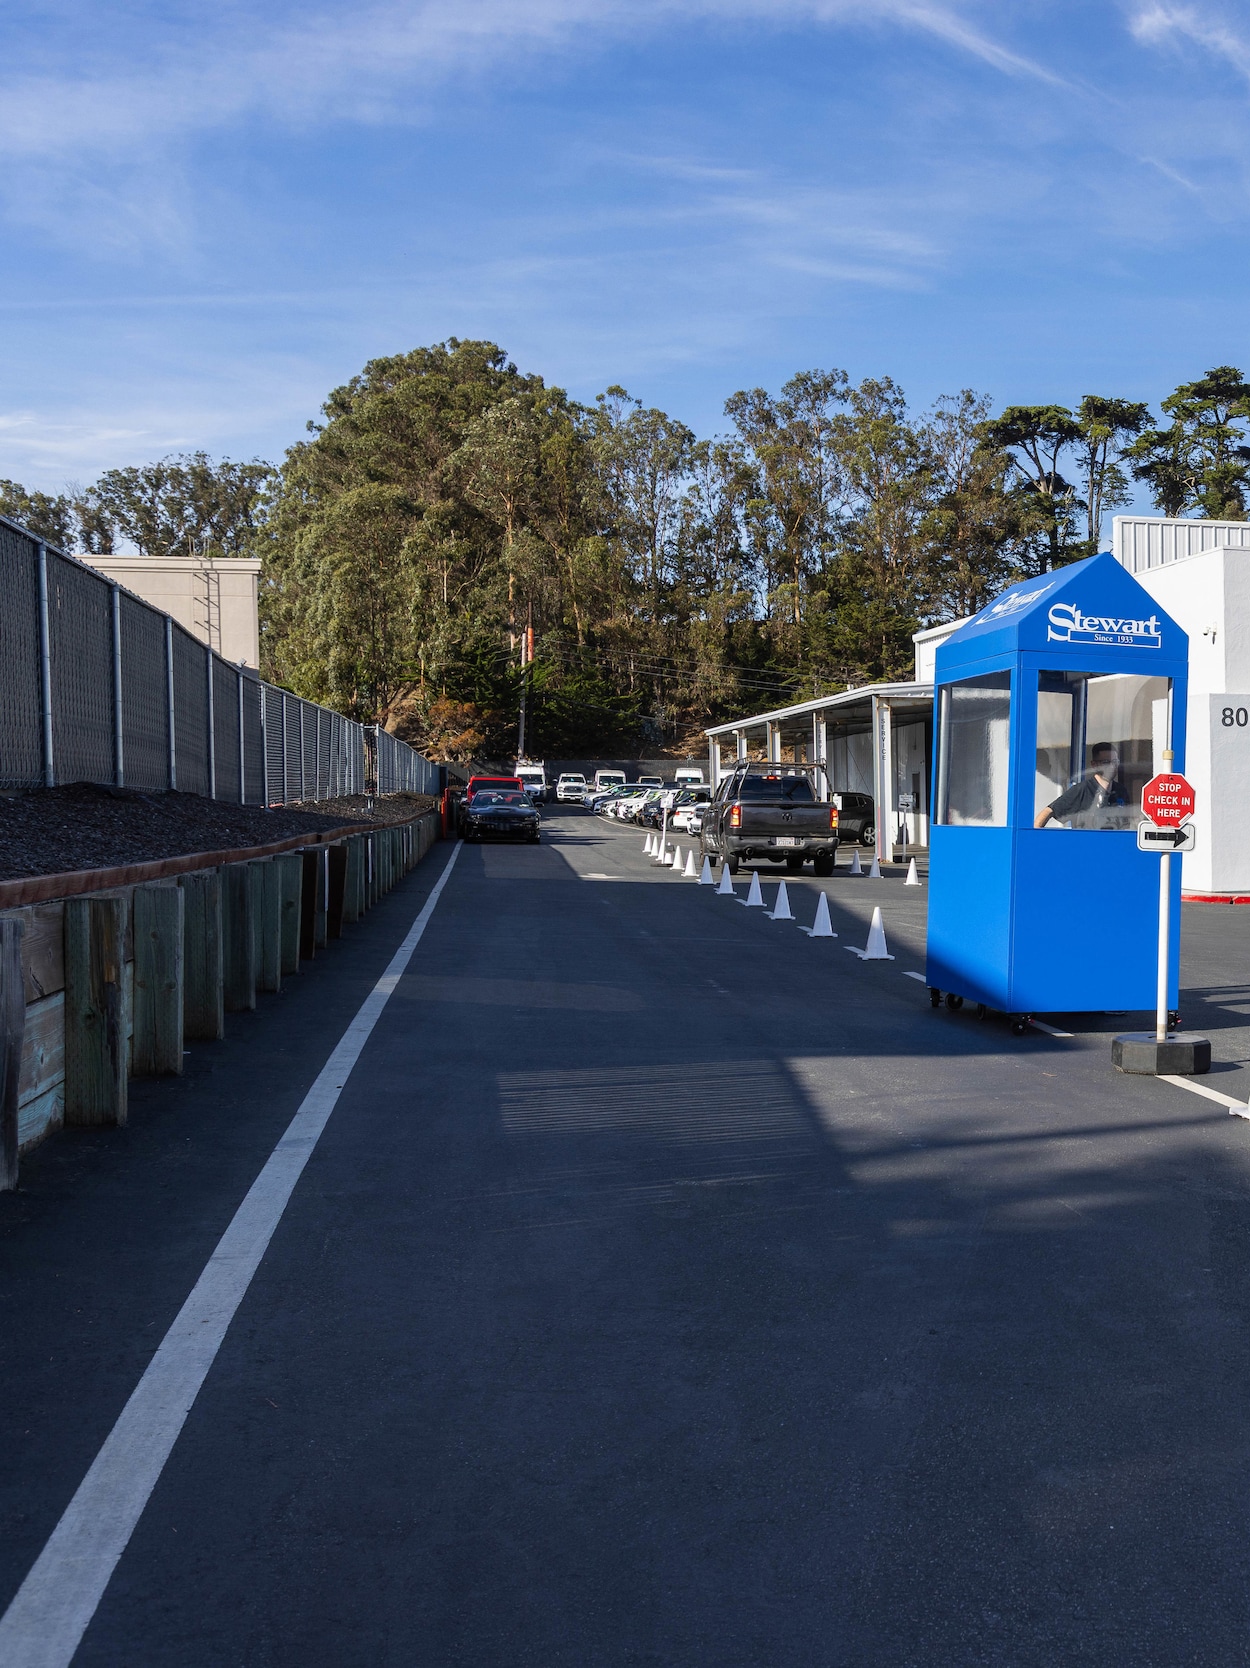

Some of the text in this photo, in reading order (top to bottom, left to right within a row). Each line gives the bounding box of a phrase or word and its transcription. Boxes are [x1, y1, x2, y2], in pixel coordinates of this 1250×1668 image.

[1047, 603, 1161, 642] Stewart
[1094, 633, 1133, 644] Since 1933
[1159, 783, 1181, 792] STOP
[1148, 795, 1191, 806] CHECK IN
[1157, 808, 1181, 818] HERE
